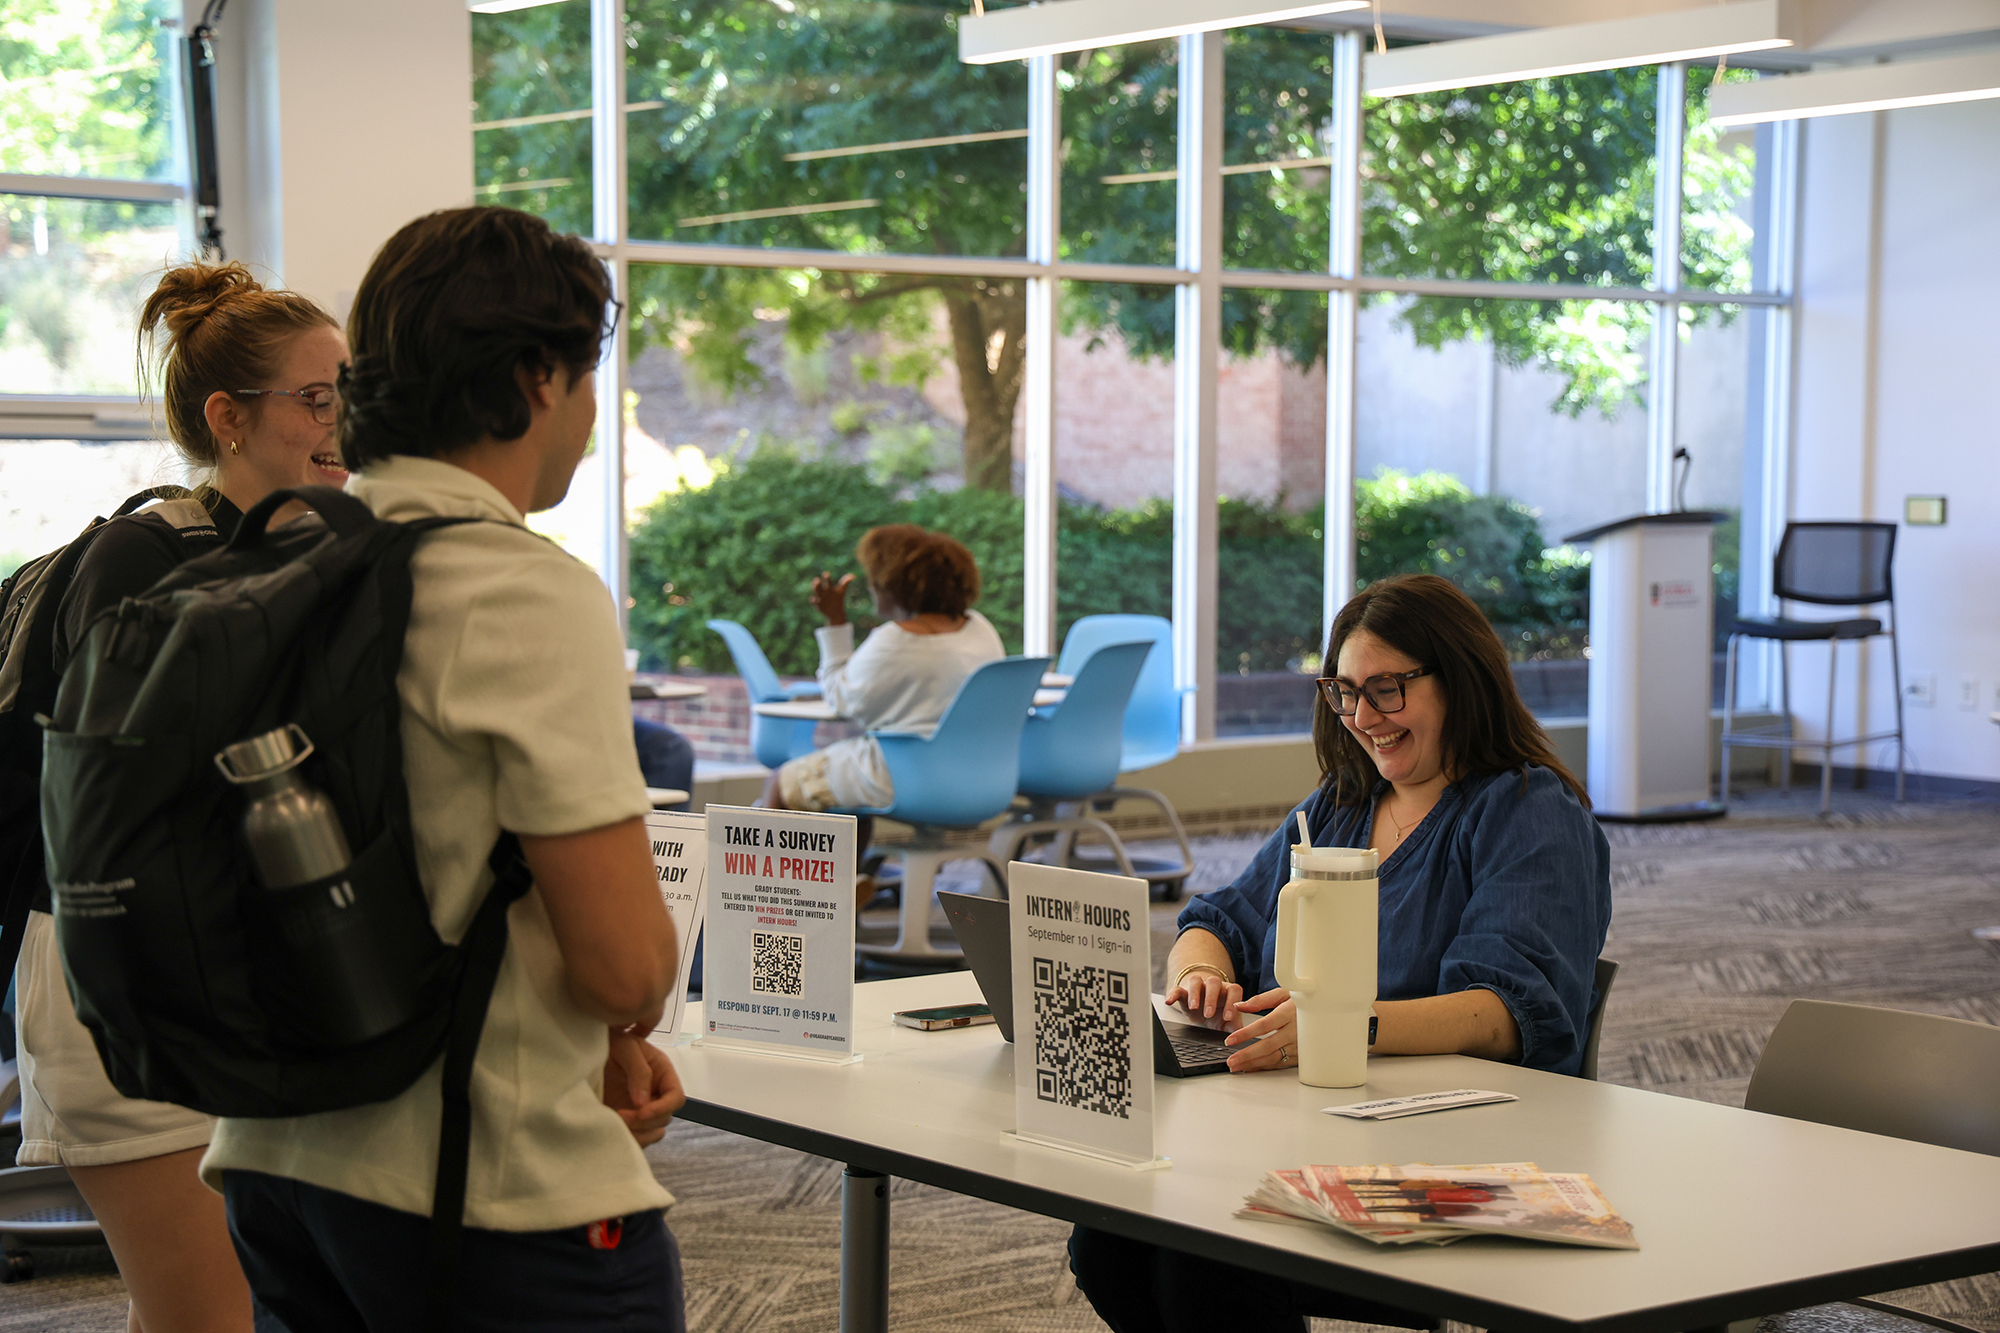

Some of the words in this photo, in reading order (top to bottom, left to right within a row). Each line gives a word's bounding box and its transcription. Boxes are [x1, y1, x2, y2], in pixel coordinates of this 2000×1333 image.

[725, 825, 760, 847] TAKE
[764, 829, 774, 848] A
[779, 830, 836, 853] SURVEY
[653, 840, 684, 858] WITH
[655, 865, 688, 883] RADY
[725, 852, 756, 876] WIN
[762, 855, 774, 878] A
[780, 856, 834, 883] PRIZE!
[676, 893, 693, 902] a.m.
[754, 884, 772, 893] GRADY
[773, 886, 801, 896] STUDENTS:
[721, 892, 732, 900] TELL
[742, 894, 757, 902] WHAT
[758, 895, 769, 904] YOU
[770, 896, 779, 905] DID
[780, 897, 793, 906] THIS
[793, 899, 816, 908] SUMMER
[817, 901, 828, 909] AND
[829, 902, 837, 910] BE
[724, 902, 746, 912] ENTERED
[747, 904, 754, 912] TO
[755, 905, 765, 913] WIN
[766, 906, 784, 915] PRIZES
[785, 908, 793, 916] OR
[794, 909, 804, 917] GET
[805, 910, 826, 919] INVITED
[826, 912, 834, 920] TO
[1026, 895, 1072, 922] INTERN
[1083, 903, 1131, 932] HOURS
[757, 916, 776, 925] INTERN
[777, 918, 798, 927] HOURS!
[1028, 925, 1075, 944] September
[1077, 936, 1088, 946] 10
[1097, 937, 1132, 954] Sign-in
[718, 1000, 750, 1013] RESPOND
[751, 1004, 761, 1014] BY
[762, 1005, 781, 1017] SEPT.
[783, 1007, 791, 1017] 17
[792, 1008, 801, 1019] @
[802, 1009, 820, 1021] 11:59
[822, 1012, 838, 1023] P.M.
